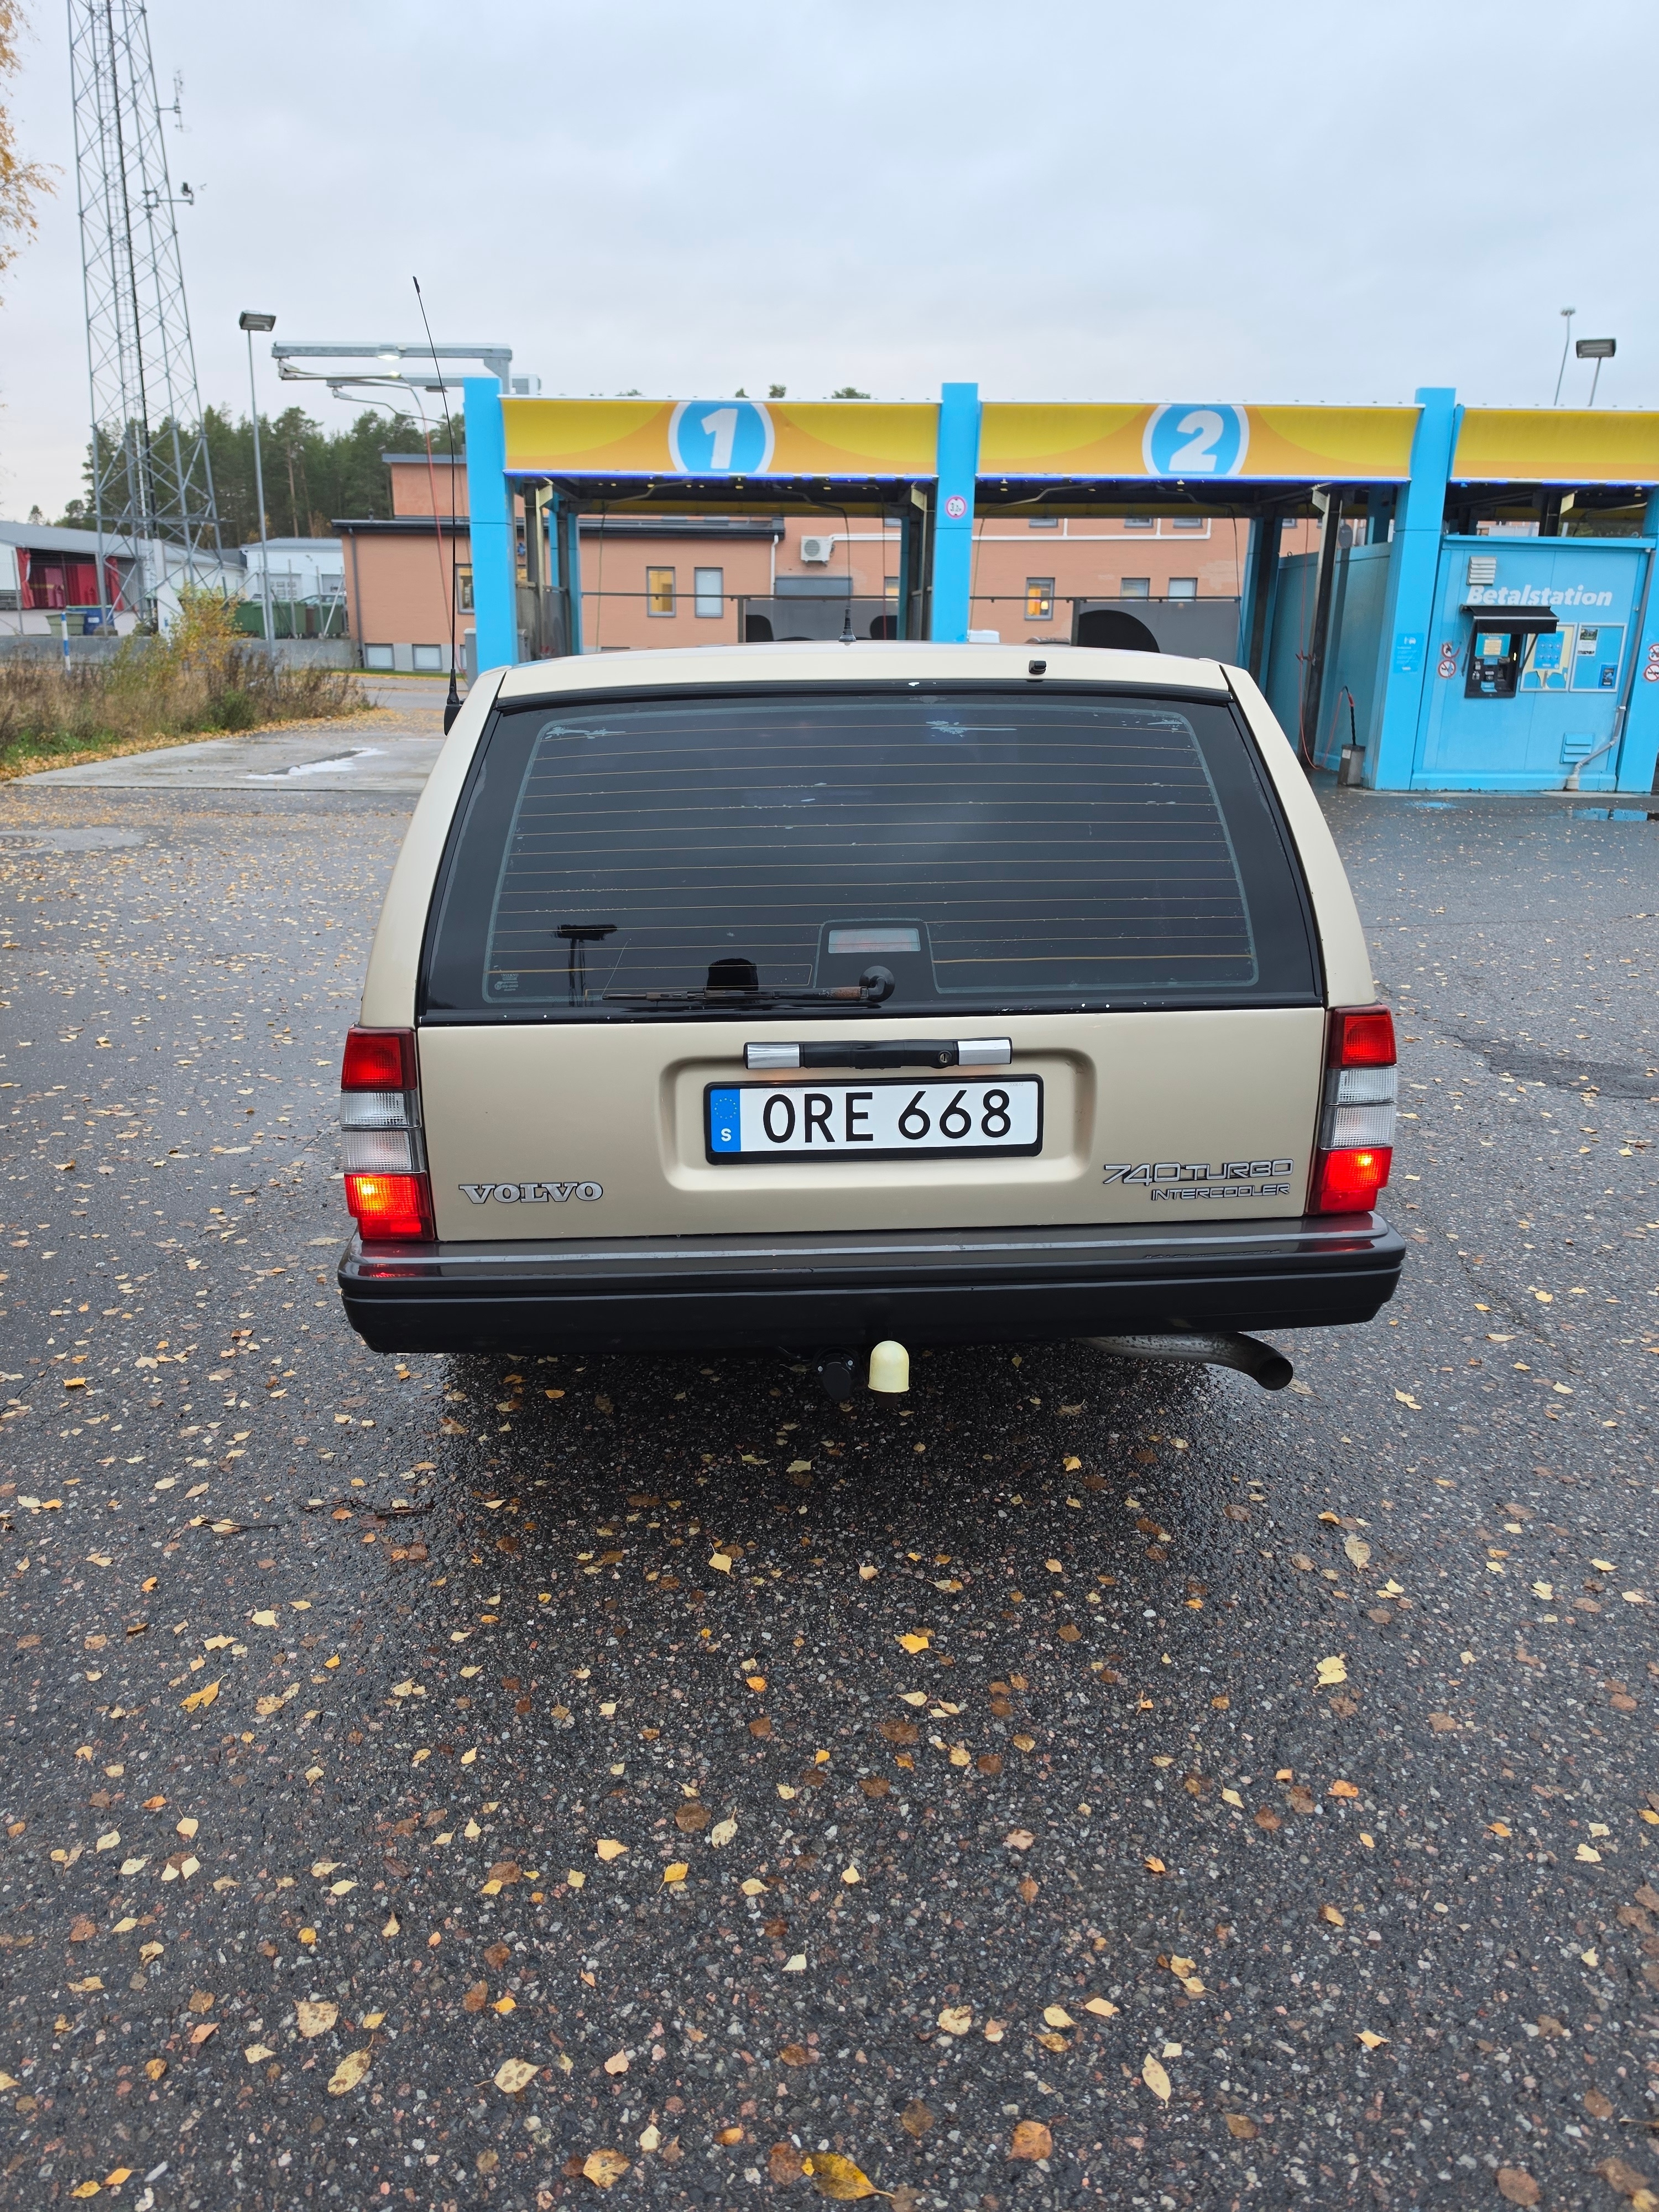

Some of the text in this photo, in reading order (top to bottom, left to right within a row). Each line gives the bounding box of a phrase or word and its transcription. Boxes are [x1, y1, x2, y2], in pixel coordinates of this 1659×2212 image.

[701, 409, 738, 469] 1
[1168, 410, 1224, 472] 2
[1467, 585, 1613, 606] Betalstation
[763, 1089, 1011, 1143] ORE 668
[721, 1128, 732, 1142] S
[1103, 1159, 1294, 1186] 740 TURBO
[458, 1181, 603, 1204] VOLVO
[1151, 1183, 1290, 1201] INTERCOOLER
